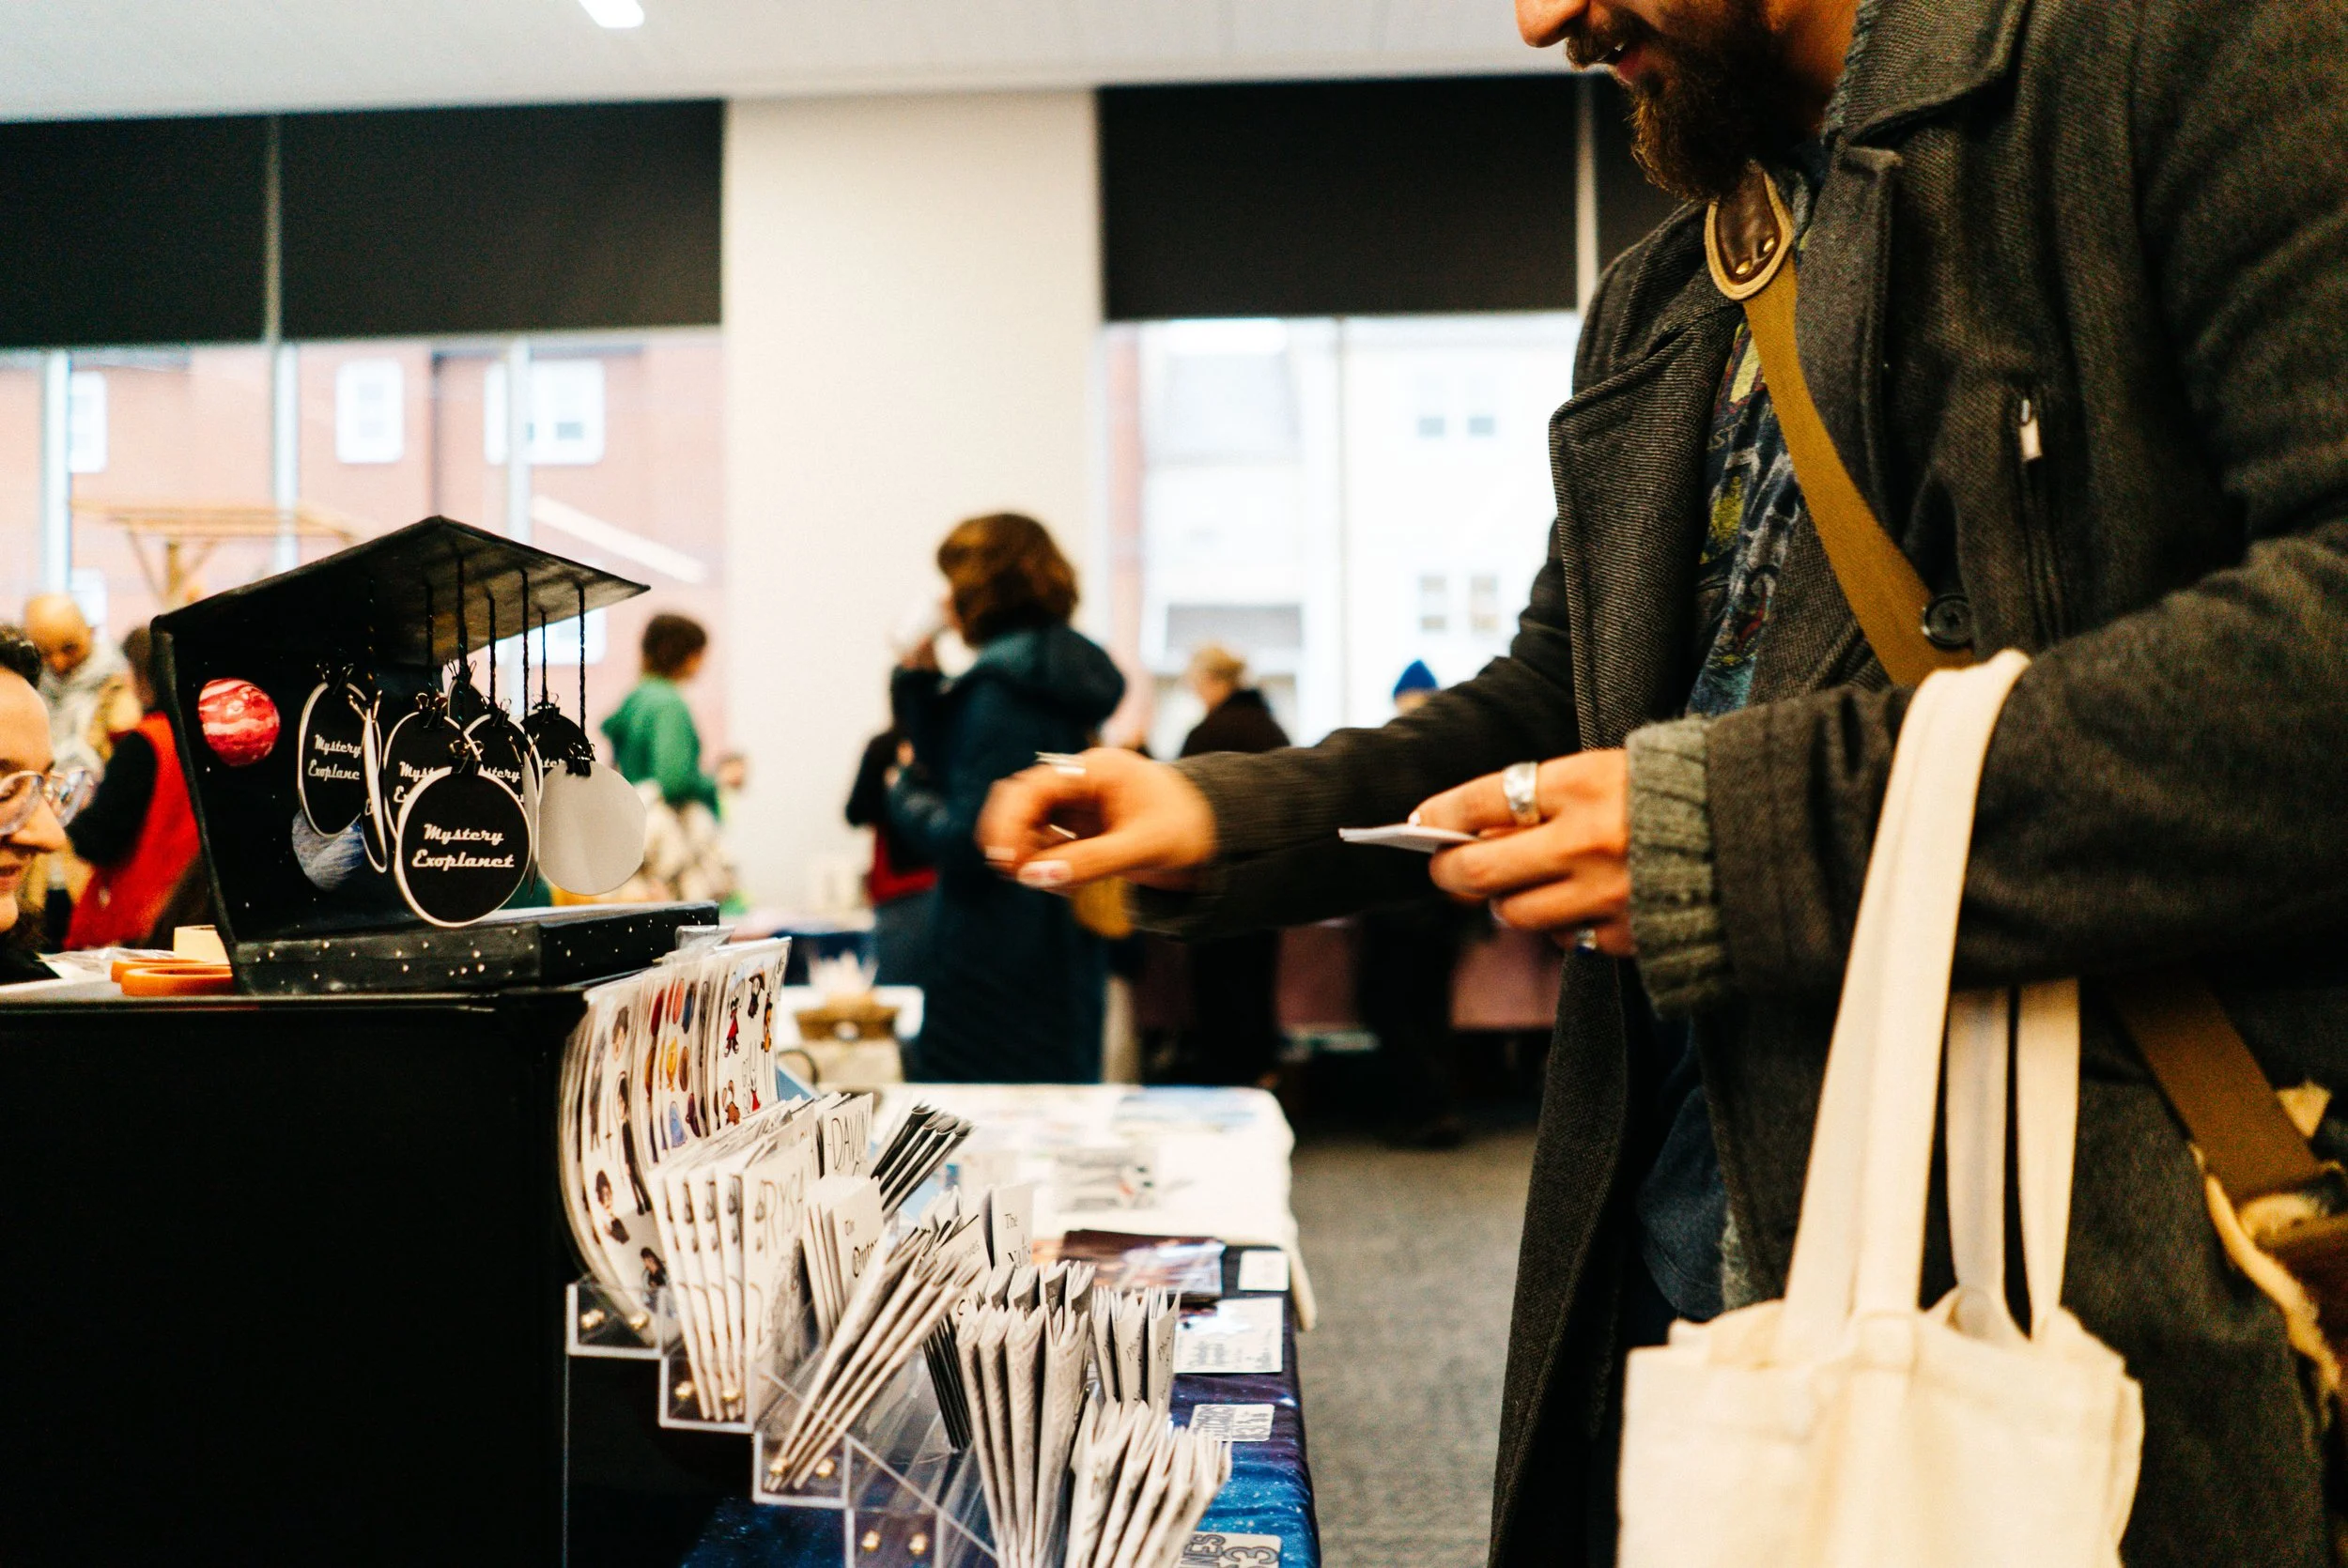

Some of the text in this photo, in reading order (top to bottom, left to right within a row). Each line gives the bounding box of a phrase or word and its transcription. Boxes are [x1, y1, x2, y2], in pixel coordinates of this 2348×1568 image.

[315, 734, 362, 759] Mystery
[307, 759, 361, 782] Exoplane
[424, 823, 504, 846] Mystery
[411, 849, 516, 871] Exoplanet
[1180, 1533, 1227, 1568] NES
[1224, 1545, 1279, 1568] 3
